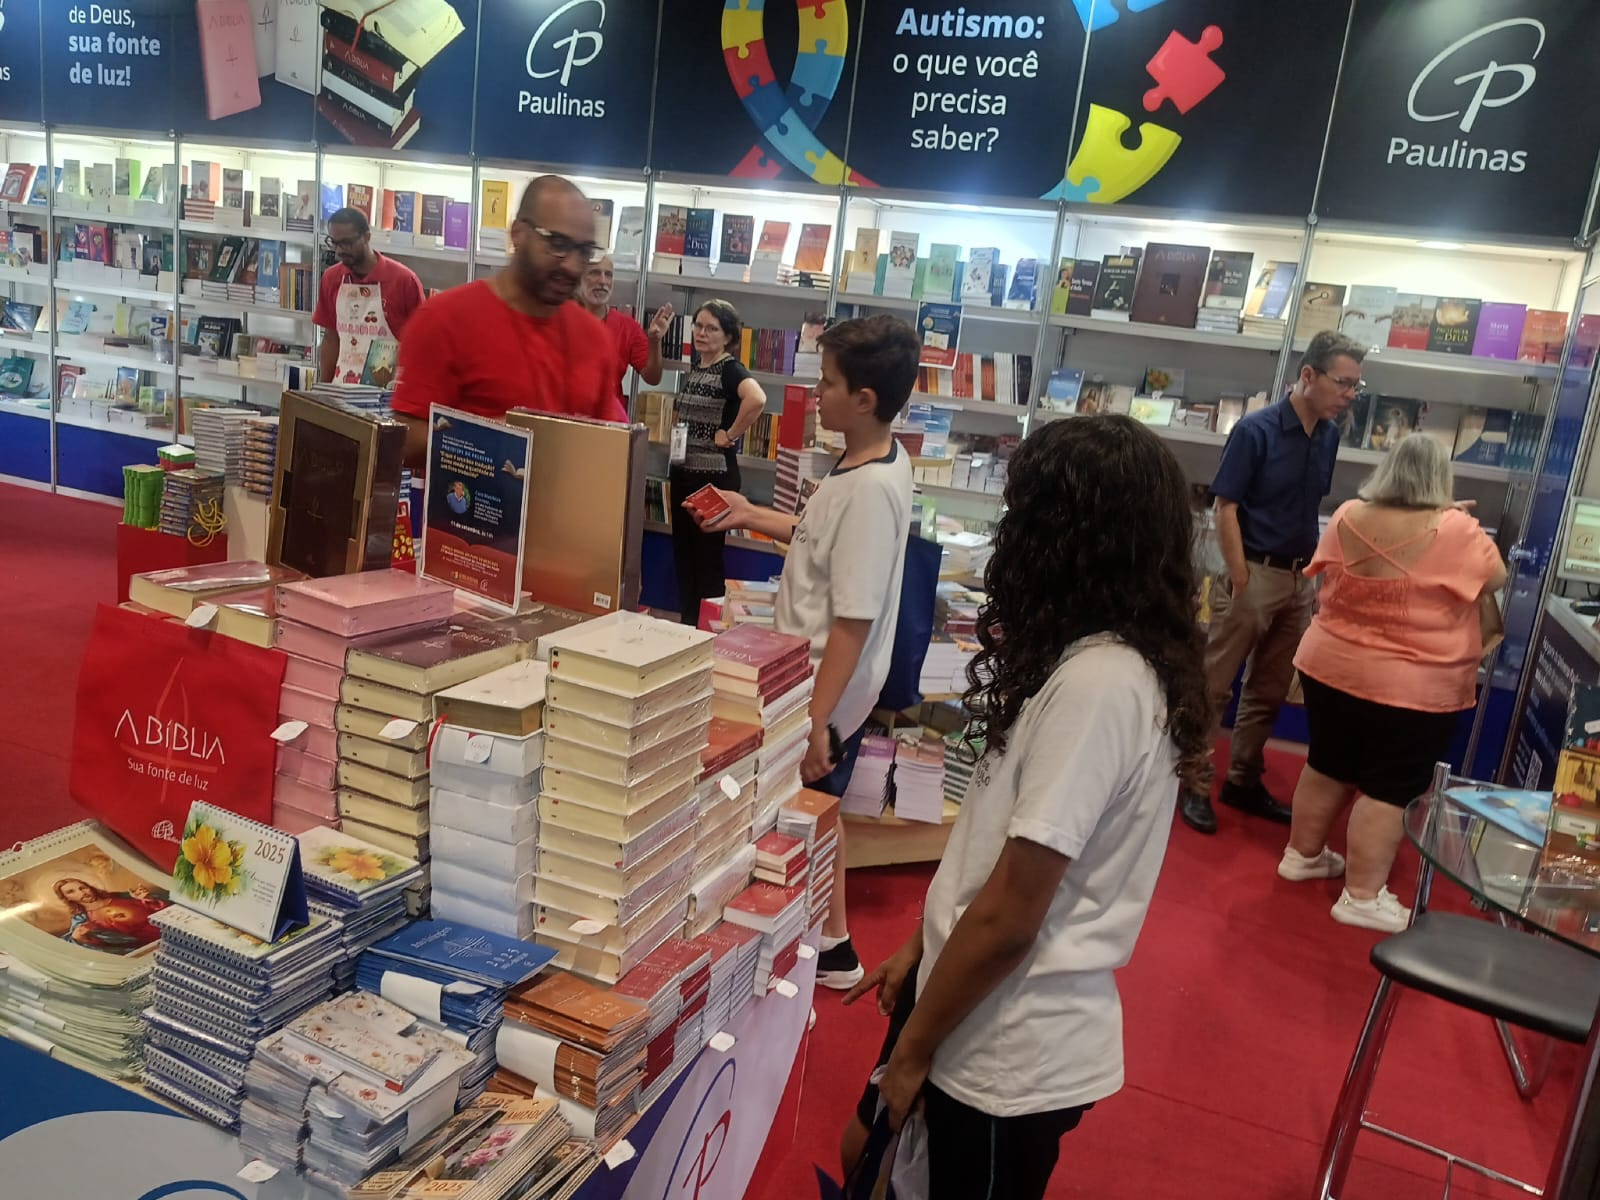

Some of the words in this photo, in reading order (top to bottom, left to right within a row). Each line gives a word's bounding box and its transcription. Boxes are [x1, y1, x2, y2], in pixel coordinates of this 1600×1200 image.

[69, 5, 86, 24] de
[90, 4, 136, 28] Deus,
[895, 7, 1045, 39] Autismo:
[69, 34, 102, 53] sua
[107, 31, 161, 56] fonte
[69, 62, 93, 85] de
[97, 63, 131, 87] luz!
[893, 53, 909, 74] o
[917, 54, 967, 82] que
[975, 50, 1039, 78] você
[517, 90, 606, 118] Paulinas
[911, 88, 1007, 118] precisa
[911, 124, 999, 152] saber?
[1387, 137, 1528, 173] Paulinas
[114, 709, 139, 745] A
[145, 715, 225, 765] BÍBLIA
[127, 757, 144, 774] Sua
[147, 761, 176, 782] fonte
[178, 770, 192, 786] de
[194, 774, 209, 791] luz
[254, 839, 286, 865] 2025
[424, 1181, 465, 1192] 2025
